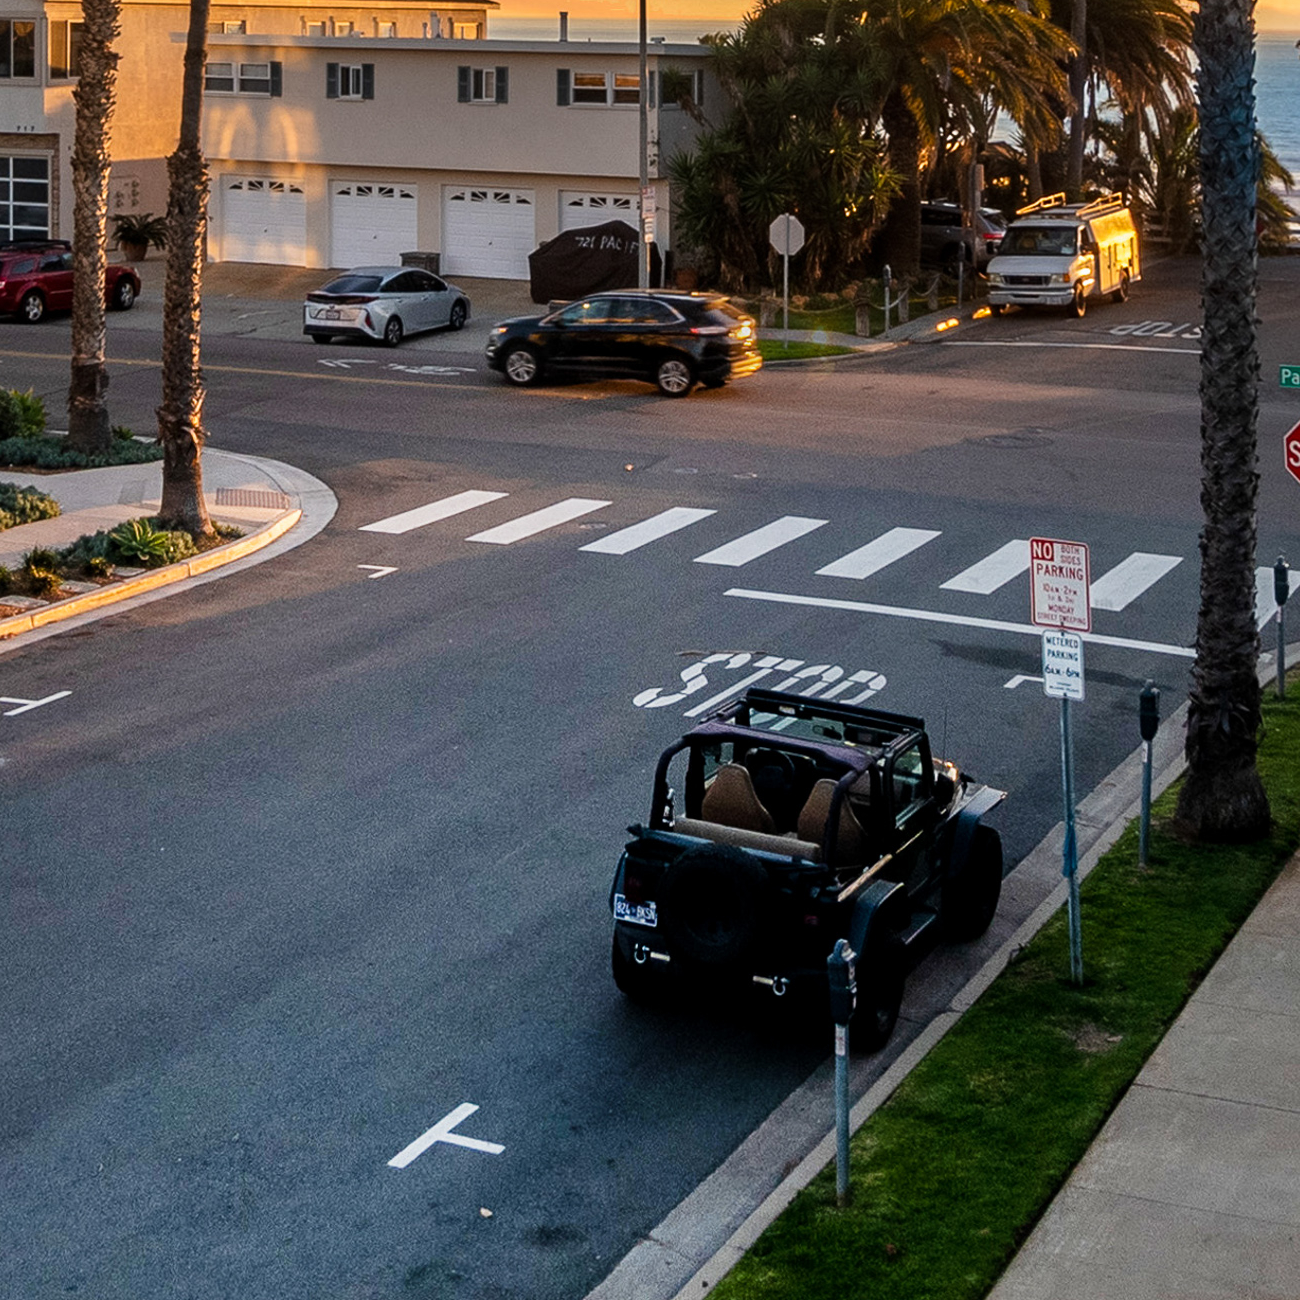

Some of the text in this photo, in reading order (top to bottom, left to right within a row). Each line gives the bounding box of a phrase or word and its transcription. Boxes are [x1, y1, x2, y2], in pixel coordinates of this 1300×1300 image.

[600, 236, 639, 254] PACIF
[1032, 541, 1053, 560] NO
[1036, 563, 1084, 581] PARKING
[1047, 604, 1075, 614] MONDAY
[1045, 636, 1079, 649] METERED
[1047, 649, 1079, 662] PARKING
